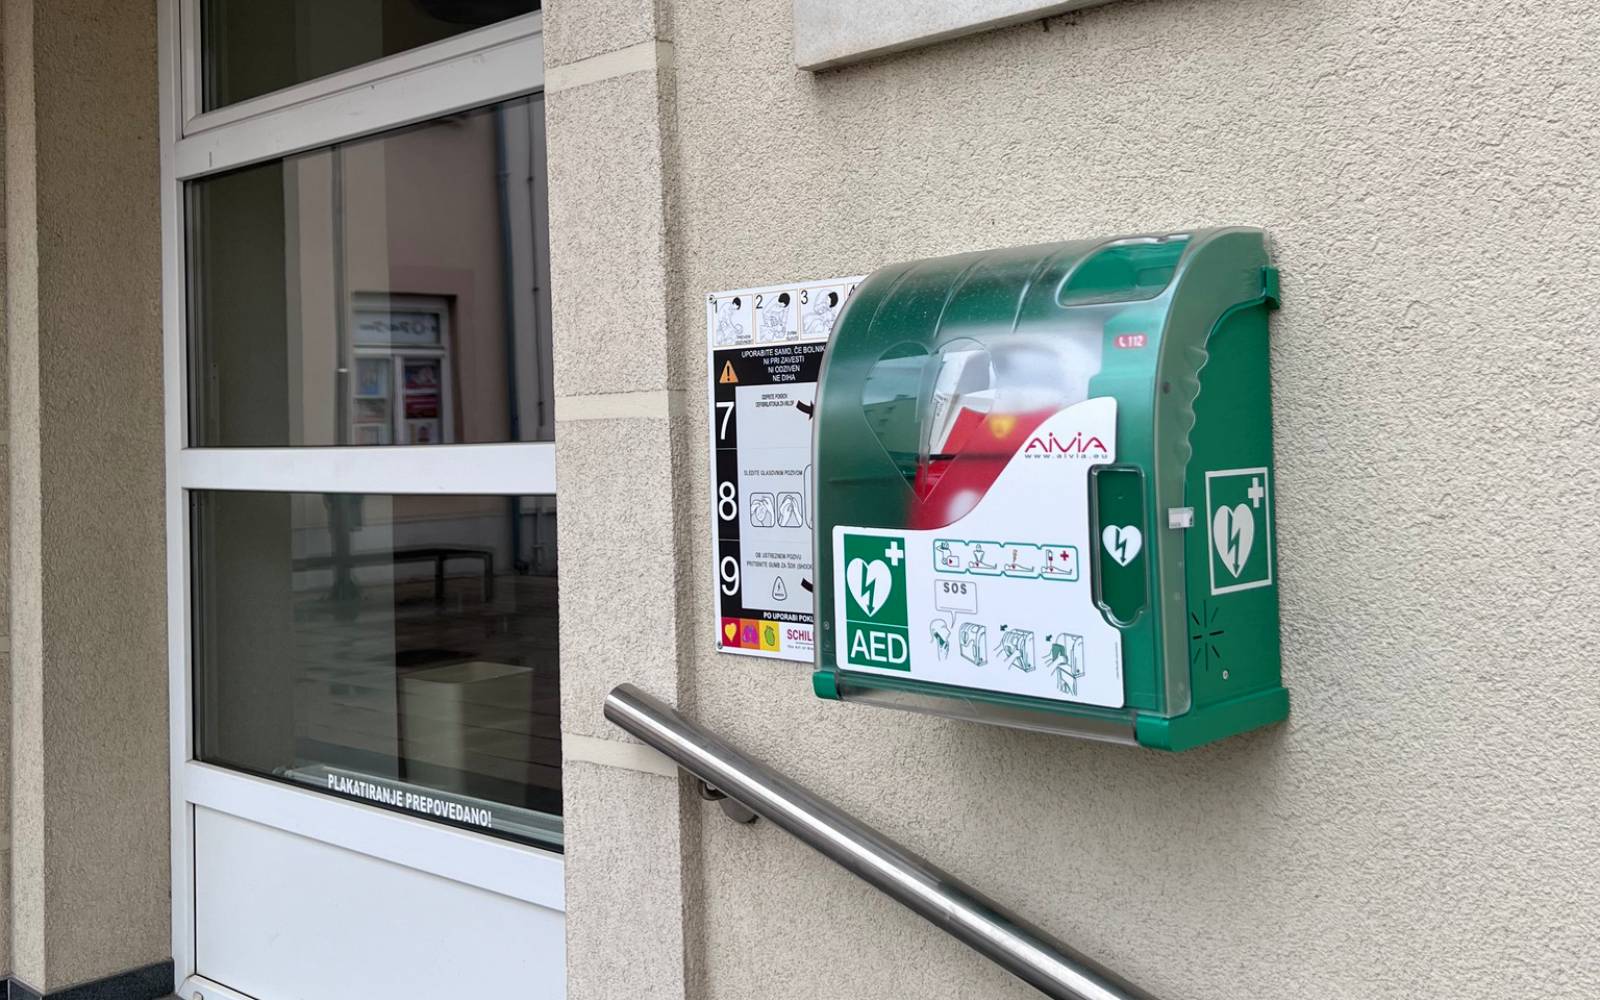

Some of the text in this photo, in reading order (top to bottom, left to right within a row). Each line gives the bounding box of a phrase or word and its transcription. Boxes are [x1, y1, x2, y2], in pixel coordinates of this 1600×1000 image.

[756, 295, 762, 309] 2
[800, 290, 808, 304] 3
[1128, 336, 1144, 346] 112
[741, 349, 774, 358] UPORABITE
[794, 346, 802, 354] ČE
[780, 356, 804, 364] ZAVESTI
[775, 365, 800, 373] ODZIVEN
[716, 401, 734, 440] 7
[718, 481, 737, 521] 8
[720, 556, 740, 596] 9
[943, 582, 967, 595] SOS
[763, 611, 772, 619] PO
[772, 612, 798, 622] UPORABI
[787, 629, 814, 641] SCHIL
[850, 629, 907, 665] AED
[328, 774, 492, 828] PLAKATIRANJE PREPOVEDANO!
